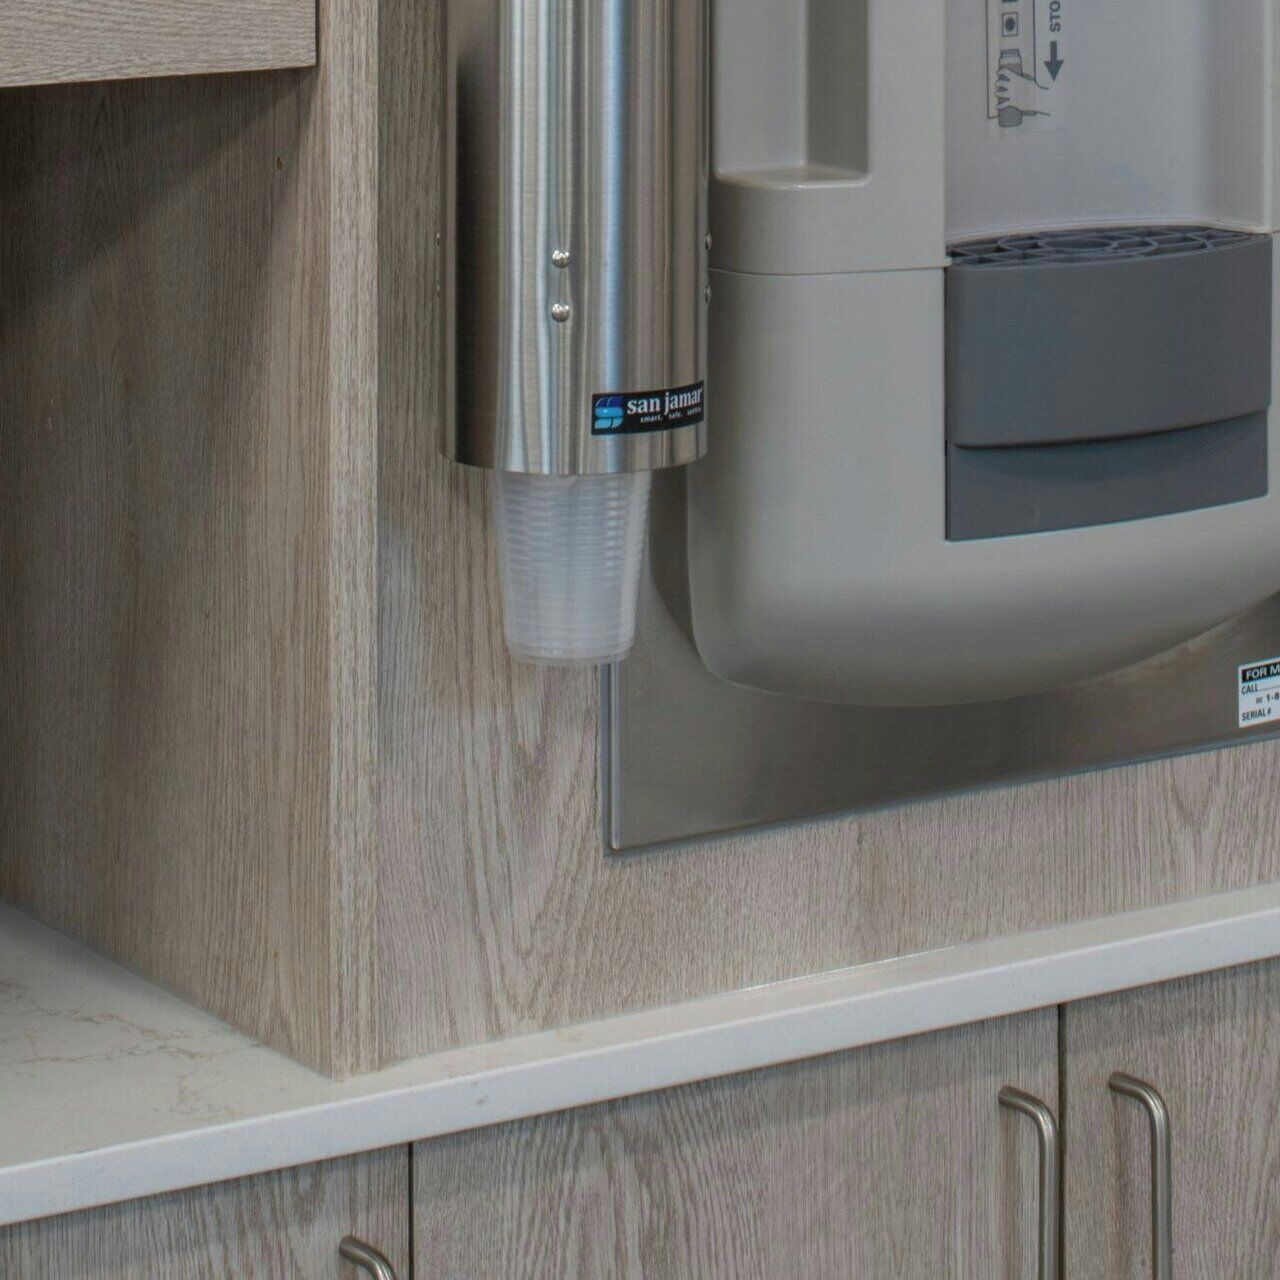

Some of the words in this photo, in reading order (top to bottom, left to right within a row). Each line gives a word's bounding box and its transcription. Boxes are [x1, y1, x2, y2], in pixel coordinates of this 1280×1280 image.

[627, 397, 661, 415] san
[664, 388, 703, 414] jamar
[1245, 667, 1267, 680] FOR
[1241, 683, 1258, 695] CALL
[1241, 708, 1266, 721] SERIAL
